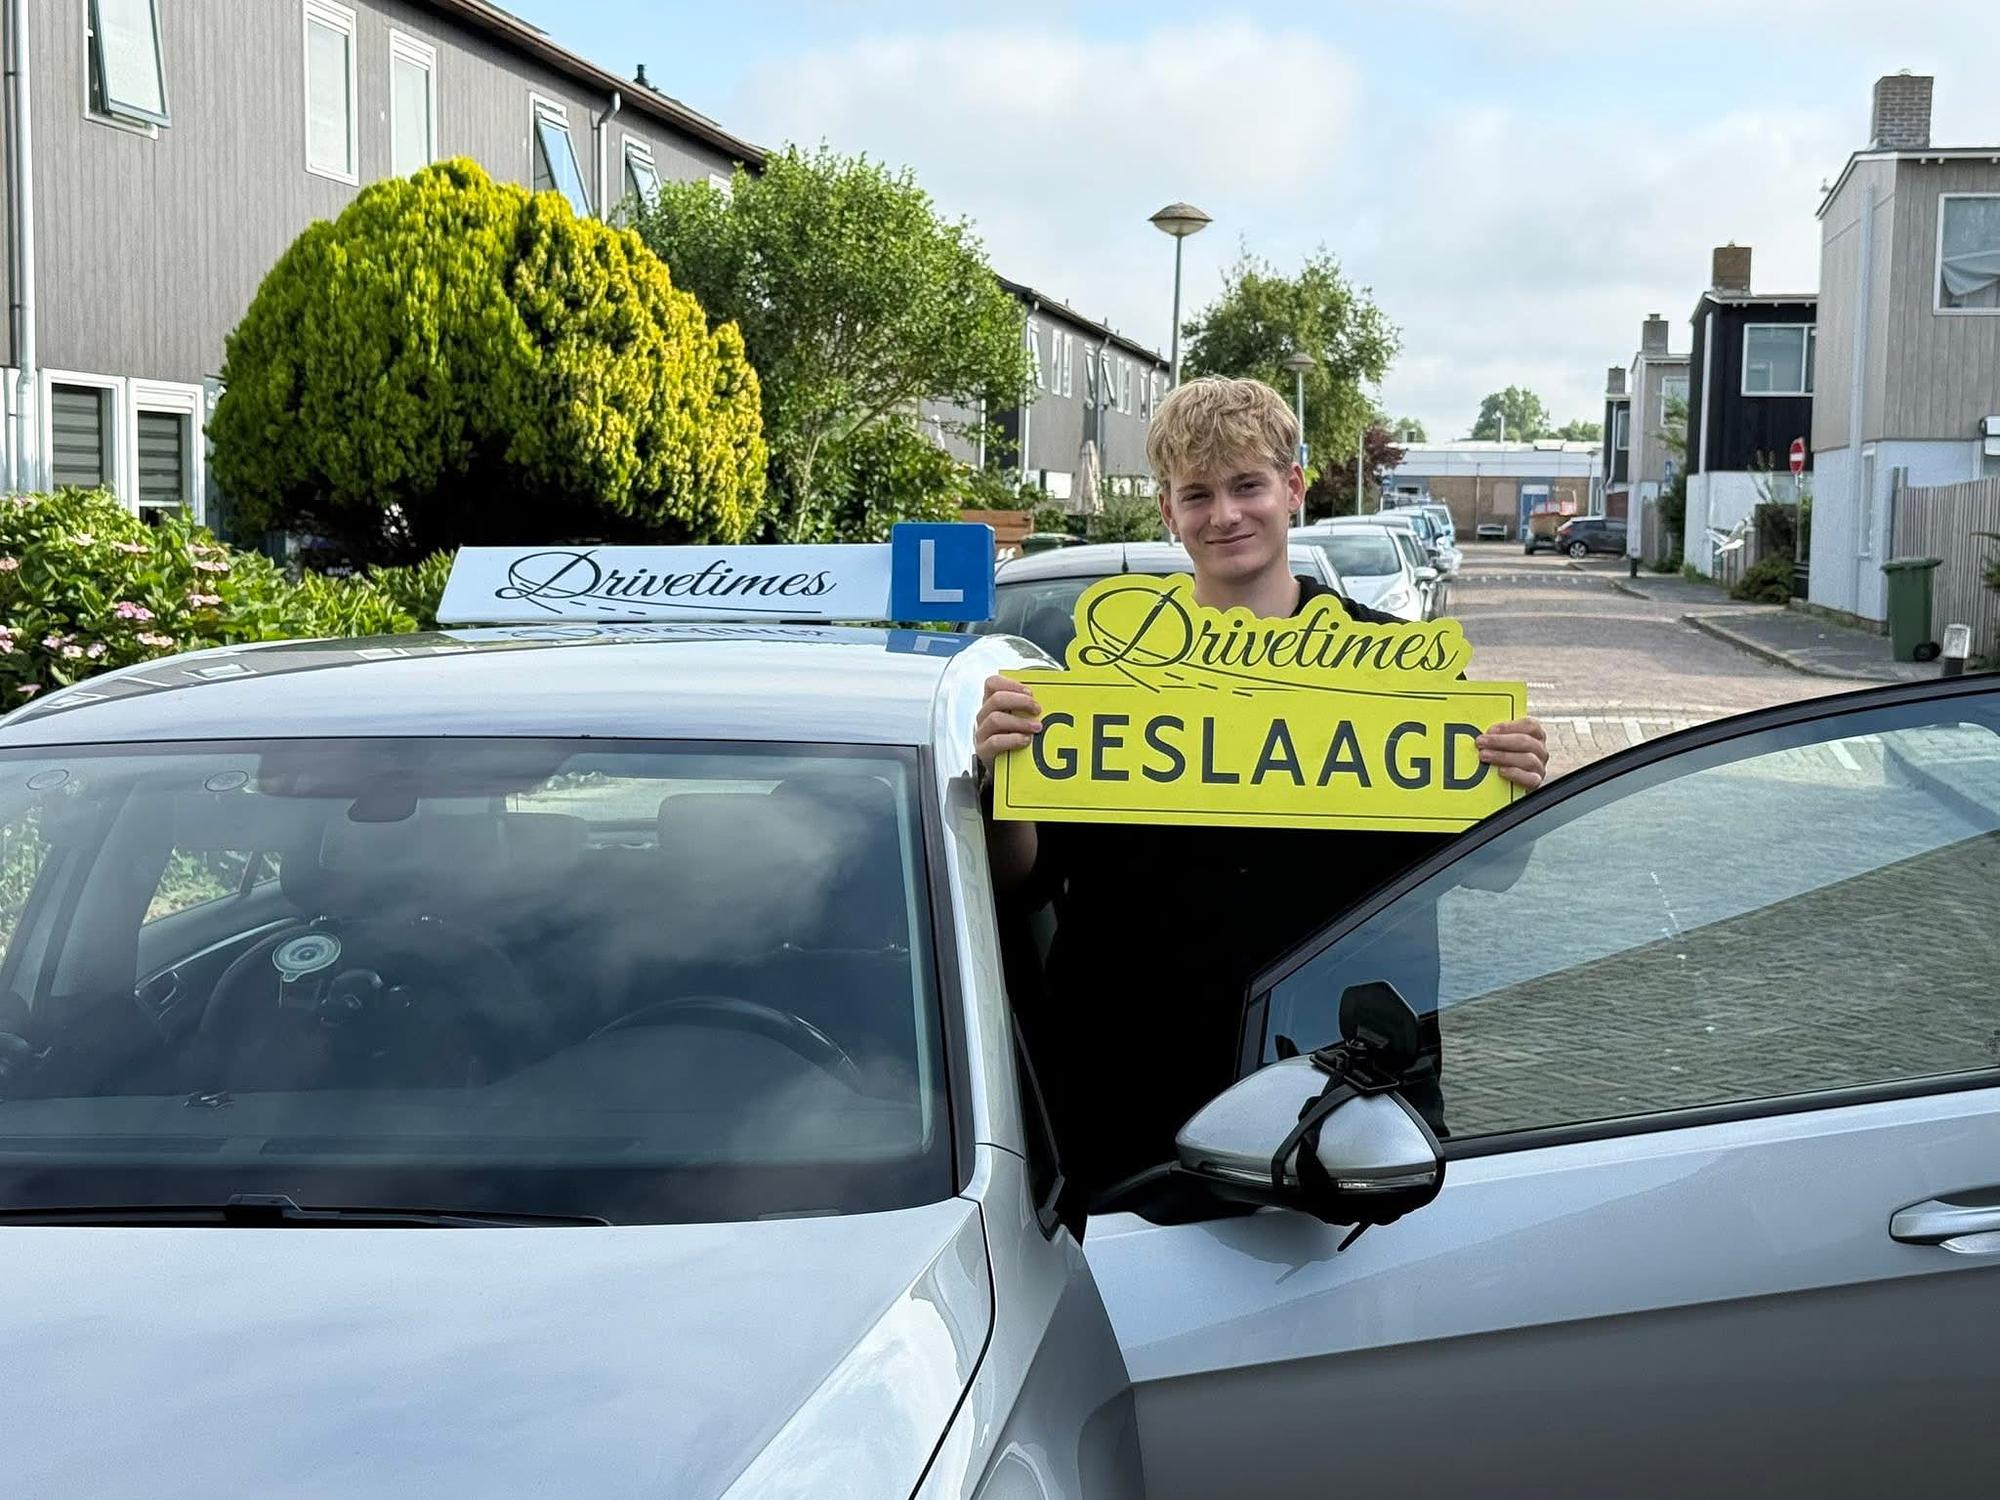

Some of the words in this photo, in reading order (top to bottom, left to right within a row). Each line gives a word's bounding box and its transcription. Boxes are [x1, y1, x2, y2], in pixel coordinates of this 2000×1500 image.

[495, 549, 837, 600] Drivetimes
[919, 539, 963, 602] L
[1079, 585, 1459, 671] Drivetimes
[1032, 712, 1490, 791] GESLAAGD
